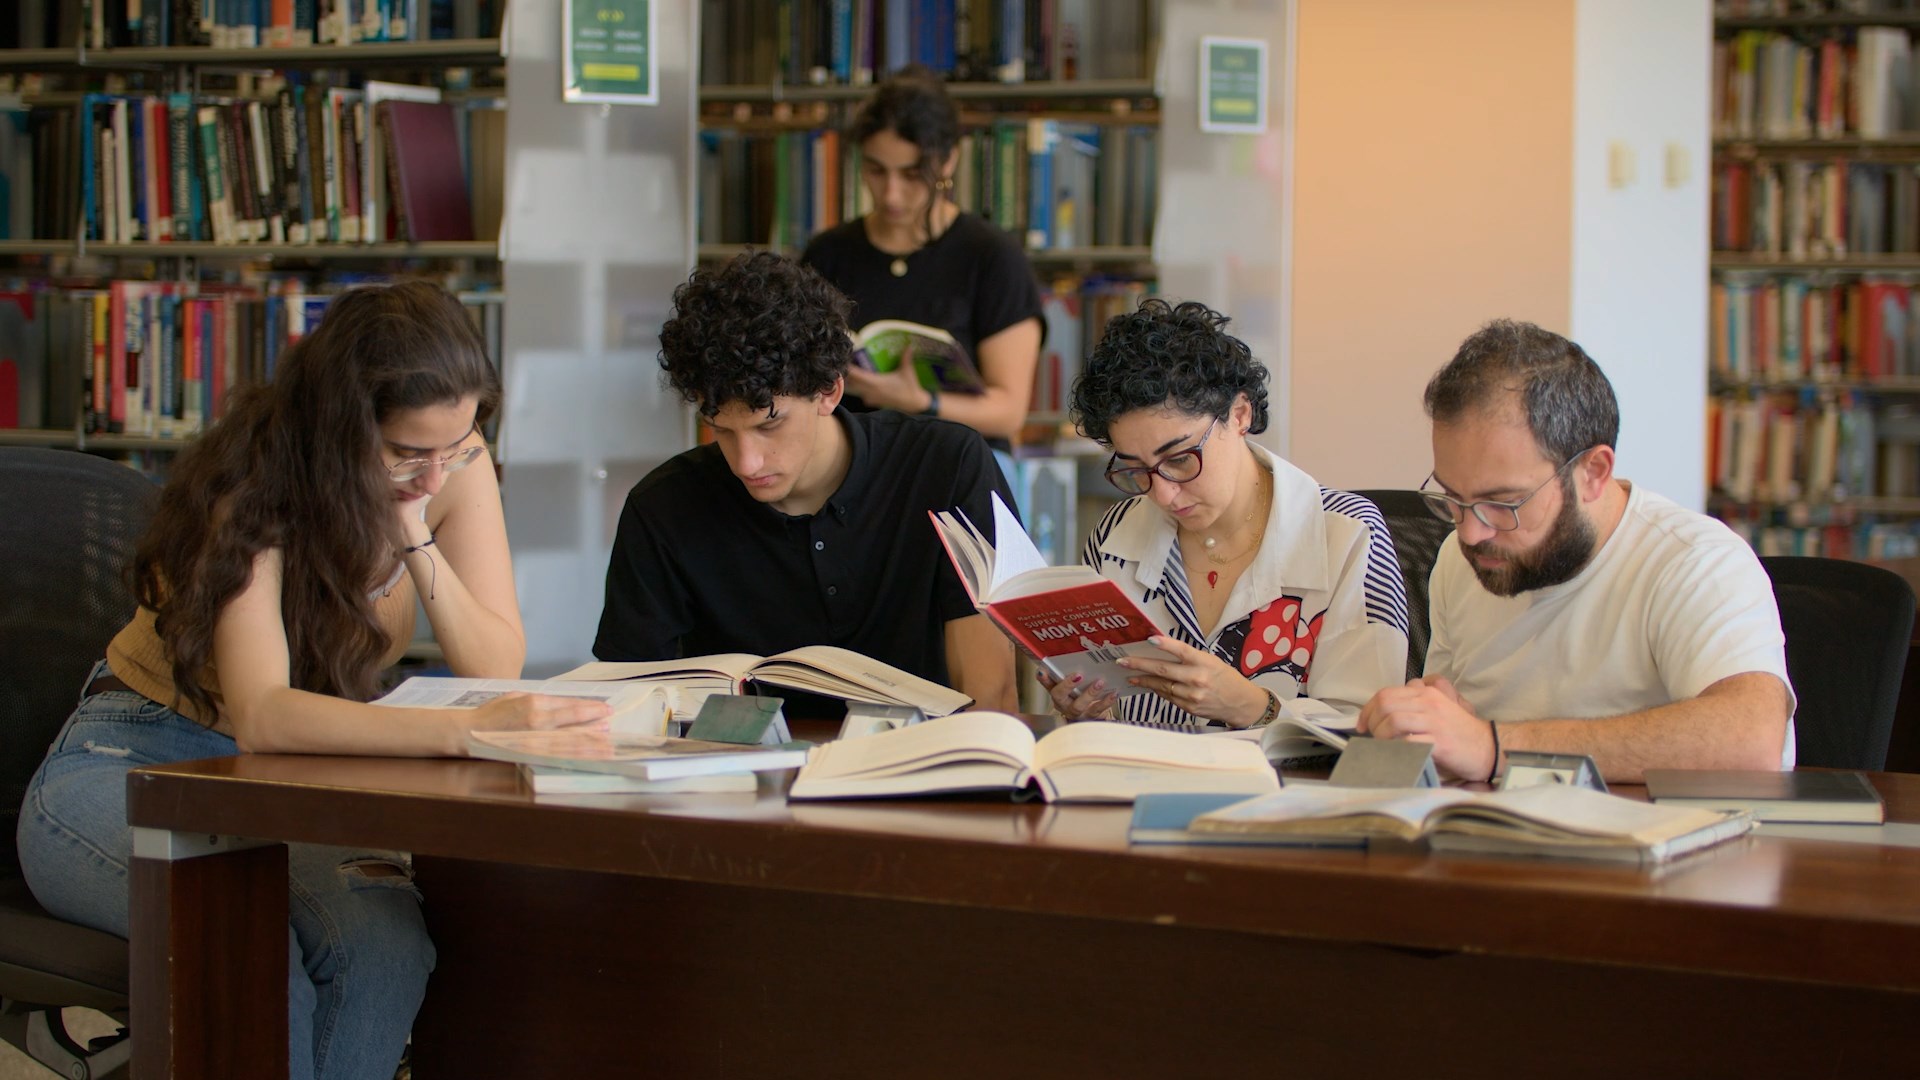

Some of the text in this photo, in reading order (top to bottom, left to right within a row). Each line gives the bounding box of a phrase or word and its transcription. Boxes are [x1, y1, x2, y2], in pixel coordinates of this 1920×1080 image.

[1024, 606, 1117, 629] SUPER CONSUMER
[1032, 614, 1130, 641] MOM & KID
